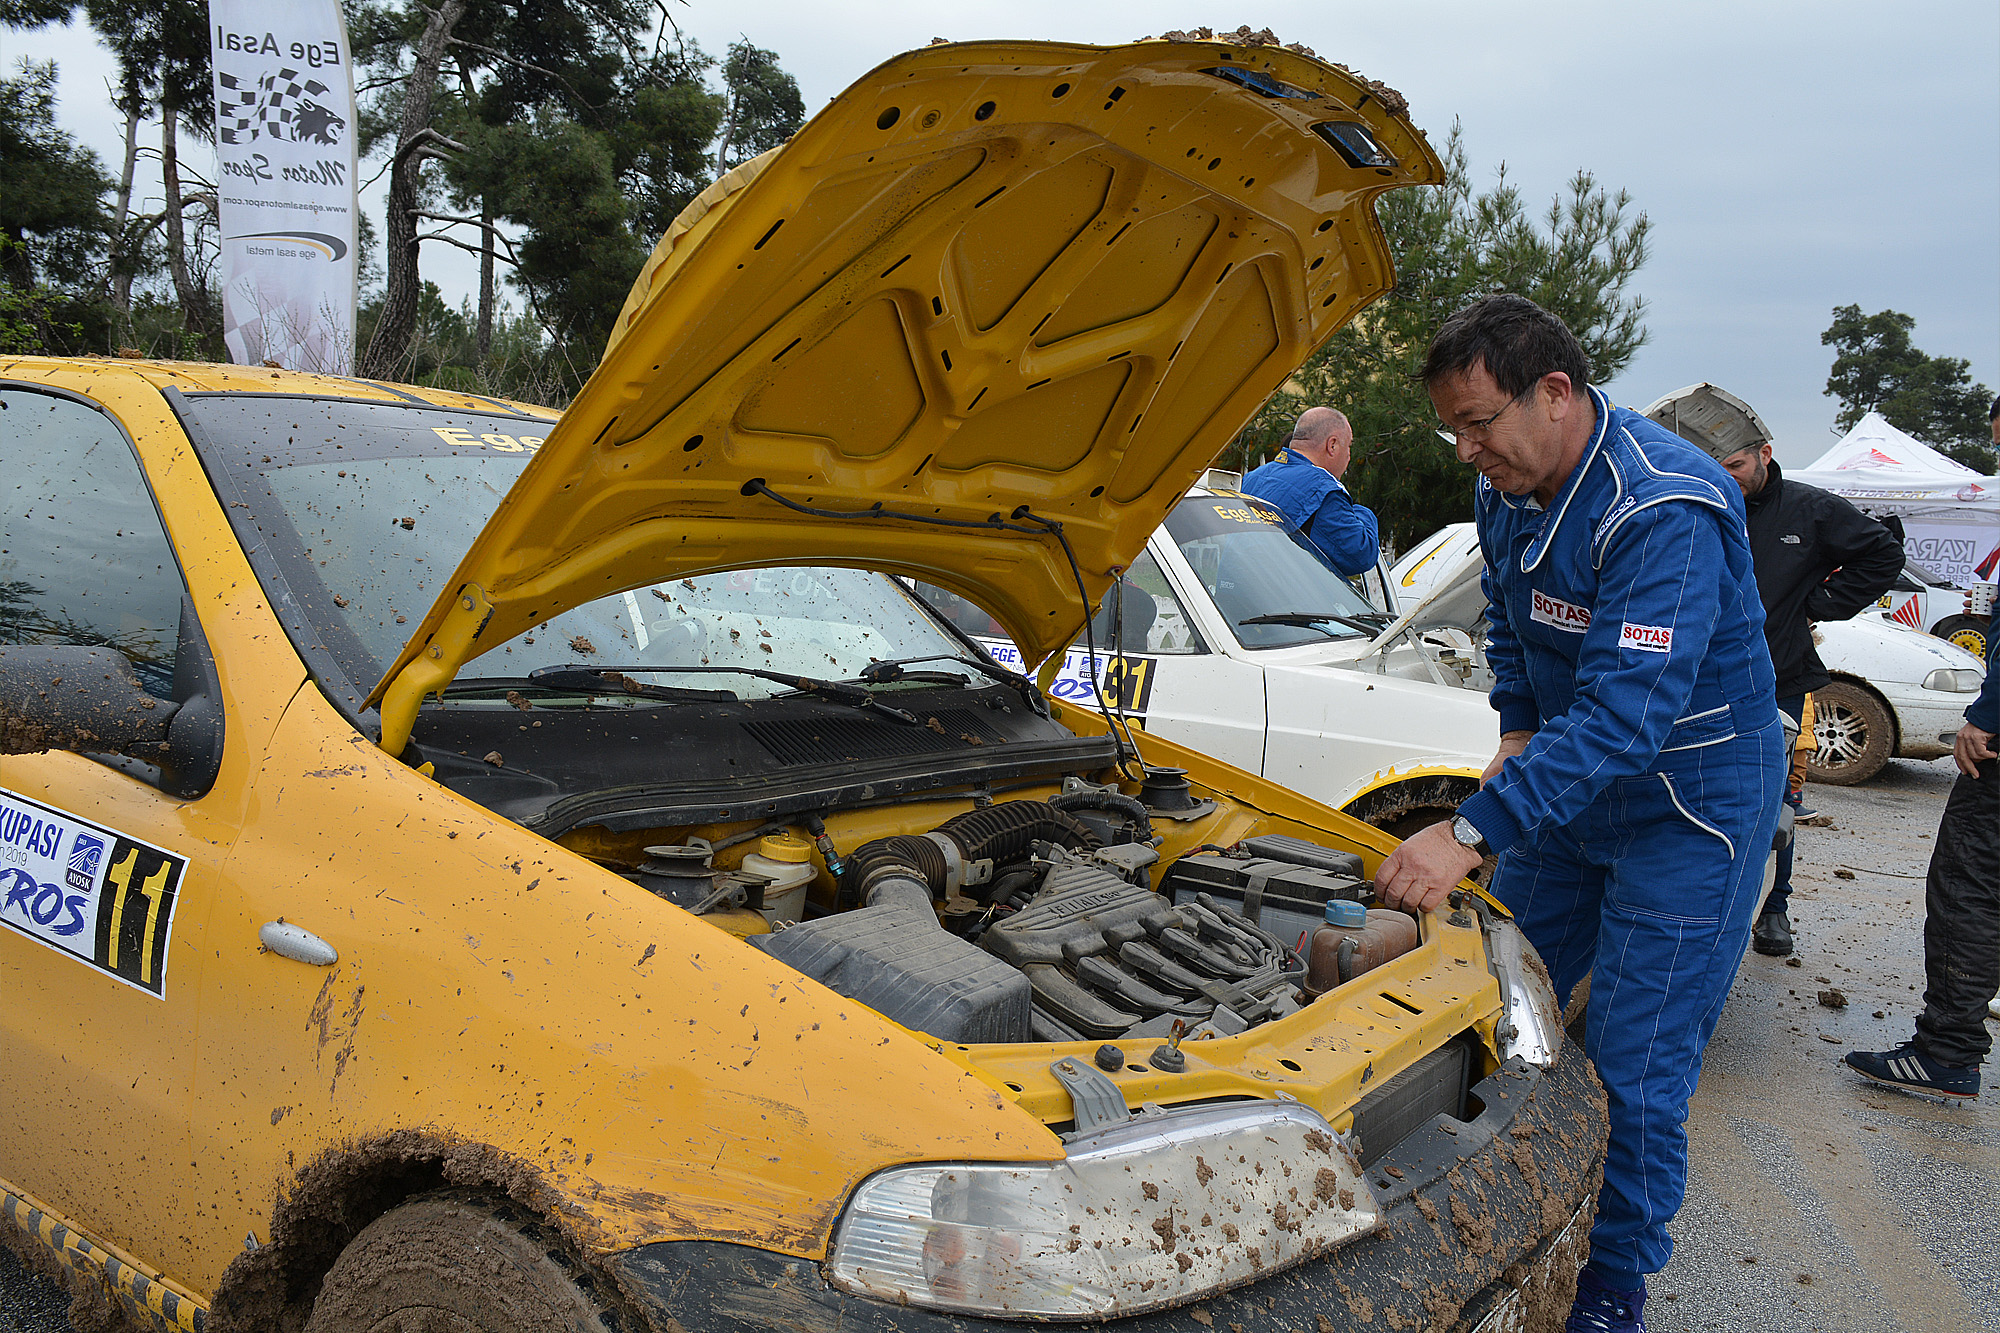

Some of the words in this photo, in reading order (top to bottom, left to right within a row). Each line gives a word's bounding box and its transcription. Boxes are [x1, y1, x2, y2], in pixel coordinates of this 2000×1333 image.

[431, 427, 546, 453] Ege
[1212, 505, 1251, 523] Ege
[1249, 506, 1285, 524] Asal
[1594, 495, 1637, 546] sparco
[1624, 626, 1670, 645] SOTAŞ
[991, 647, 1017, 663] EGE
[1102, 657, 1149, 711] 31
[6, 846, 28, 867] 2019
[67, 871, 91, 890] AYOSK
[1055, 894, 1102, 914] FIAT
[108, 847, 172, 984] 11
